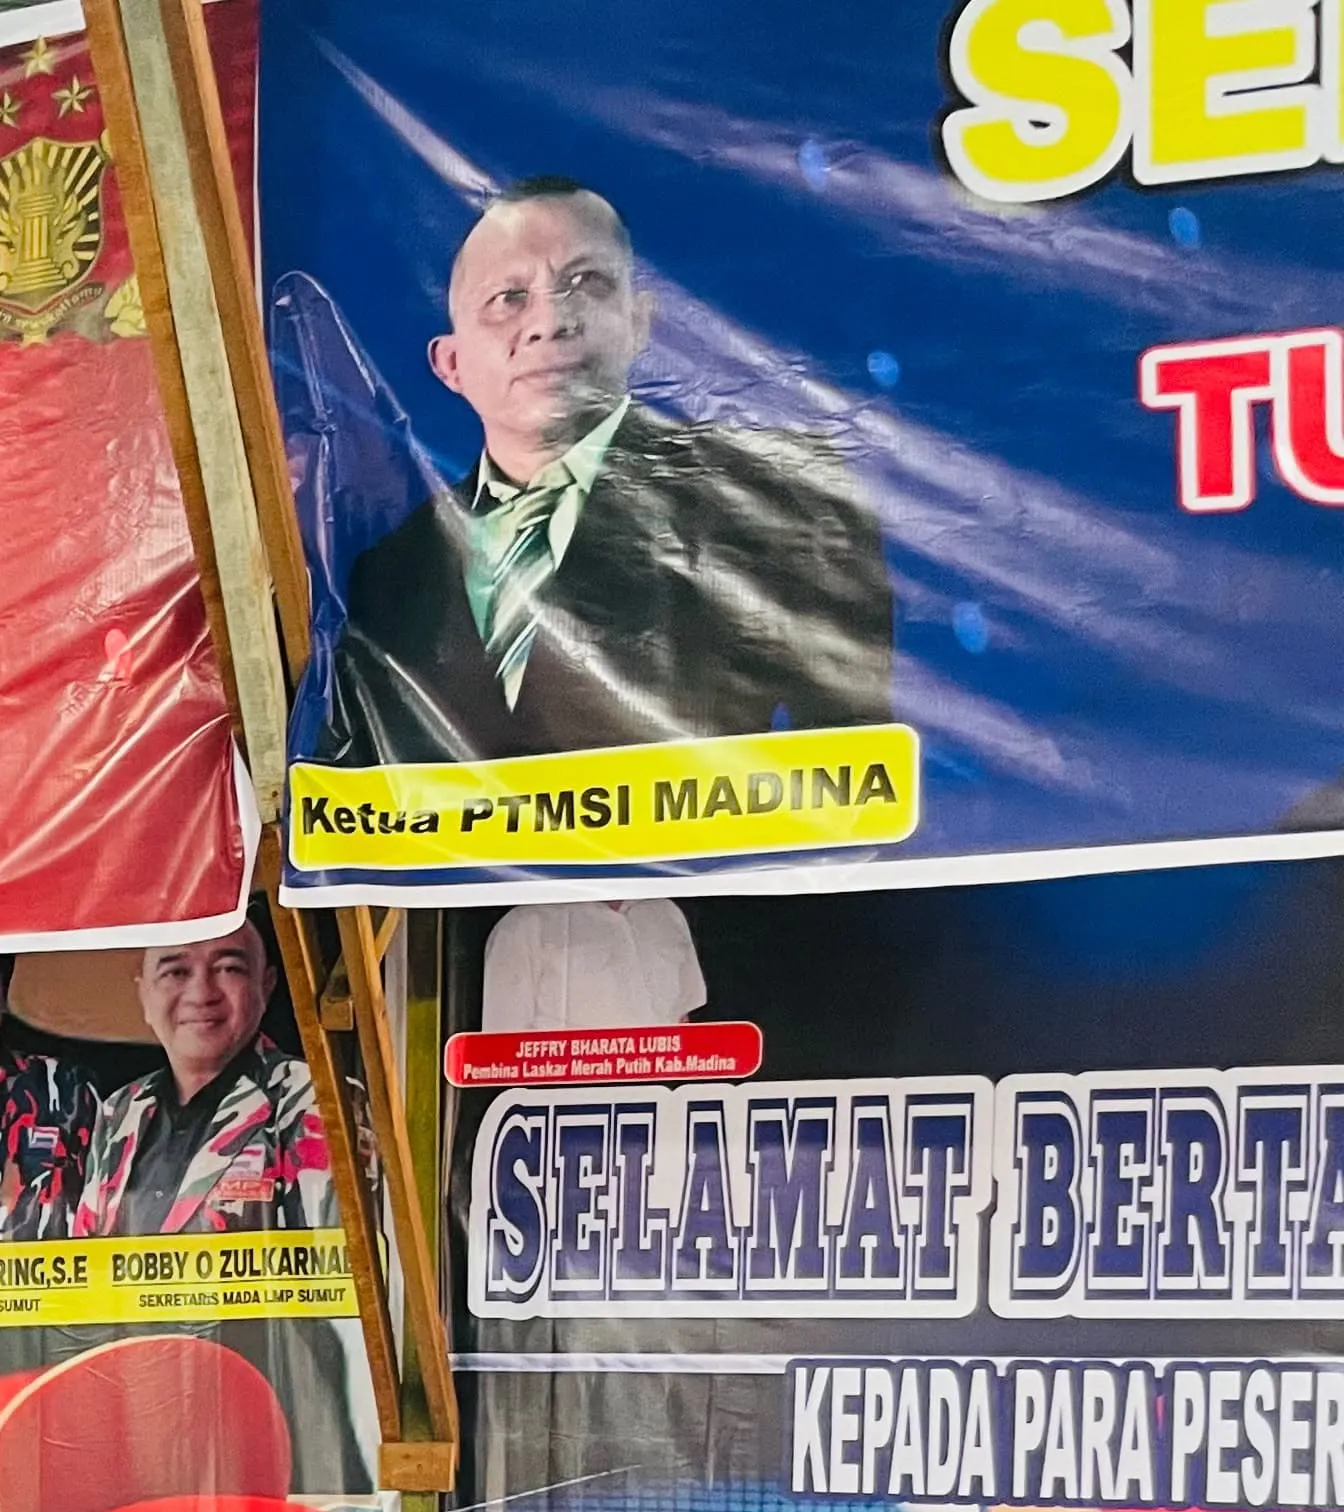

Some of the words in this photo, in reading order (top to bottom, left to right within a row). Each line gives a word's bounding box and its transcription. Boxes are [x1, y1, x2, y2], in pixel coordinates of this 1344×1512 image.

[962, 0, 1344, 183] SE
[300, 795, 440, 837] Ketua
[459, 785, 632, 833] PTMSI
[653, 764, 897, 822] MADINA
[462, 1062, 519, 1080] Pembina
[522, 1060, 568, 1078] Laskar
[570, 1058, 613, 1077] Merah
[615, 1057, 652, 1075] Putih
[654, 1053, 736, 1073] Kab.Madina
[515, 1039, 568, 1058] JEFFRY
[570, 1037, 636, 1056] BHARATA
[638, 1034, 682, 1054] LUBIS
[484, 1090, 977, 1304] SELAMAT
[111, 1249, 190, 1283] BOBBY
[195, 1248, 213, 1281] O
[138, 1292, 219, 1308] SEKRETARIS
[222, 1290, 262, 1306] MADA
[263, 1289, 295, 1304] LMP
[296, 1287, 347, 1303] SUMUT
[790, 1364, 995, 1499] KEPADA
[1013, 1366, 1150, 1503] PARA
[1171, 1367, 1344, 1507] PESER
